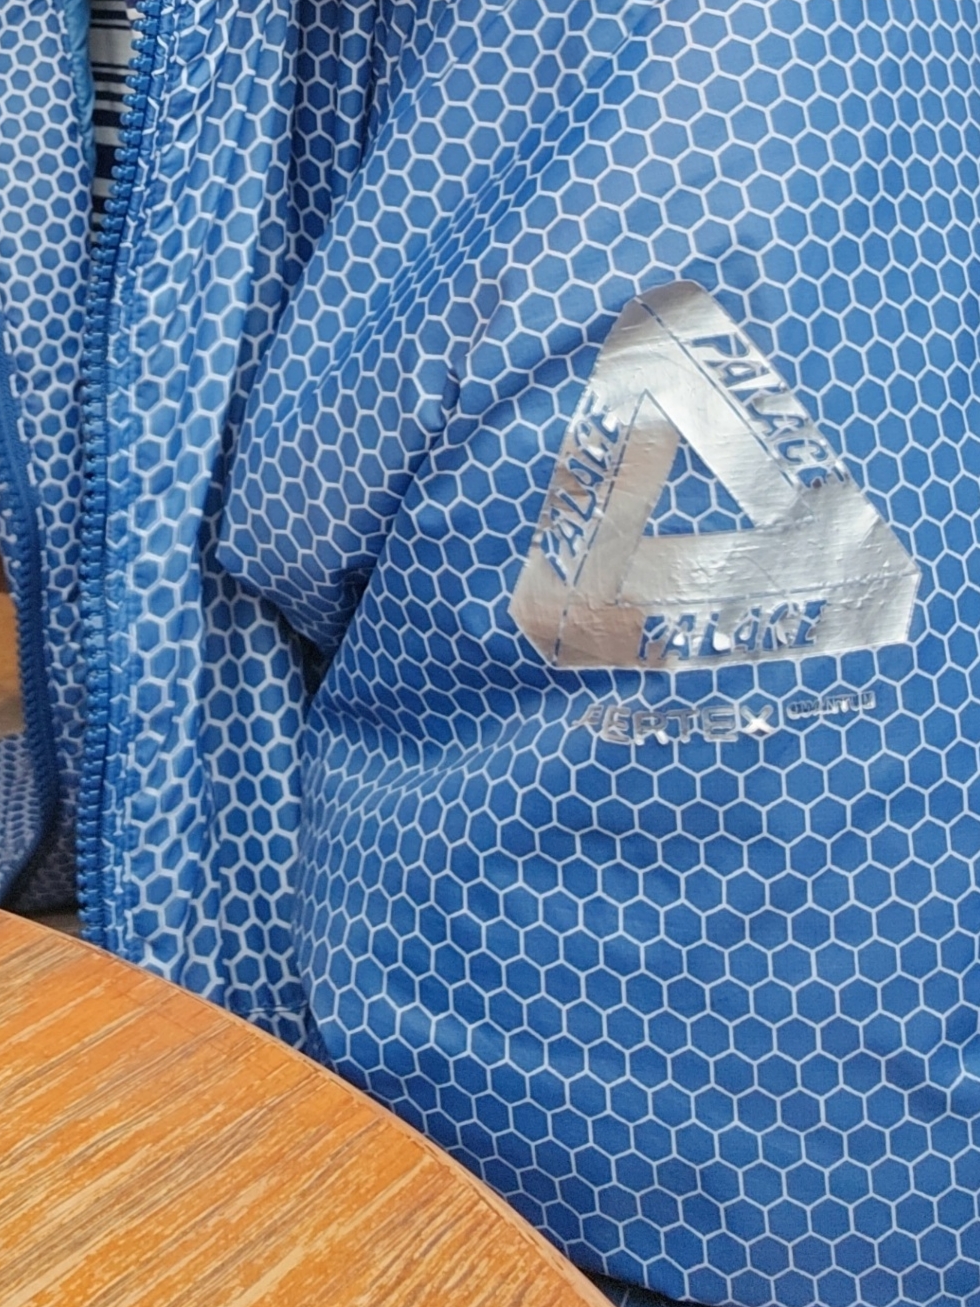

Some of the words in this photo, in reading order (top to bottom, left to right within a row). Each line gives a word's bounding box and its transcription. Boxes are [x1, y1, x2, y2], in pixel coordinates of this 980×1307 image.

[542, 390, 622, 586] PALACE
[691, 332, 850, 490] PALACE
[637, 599, 828, 661] PALACE
